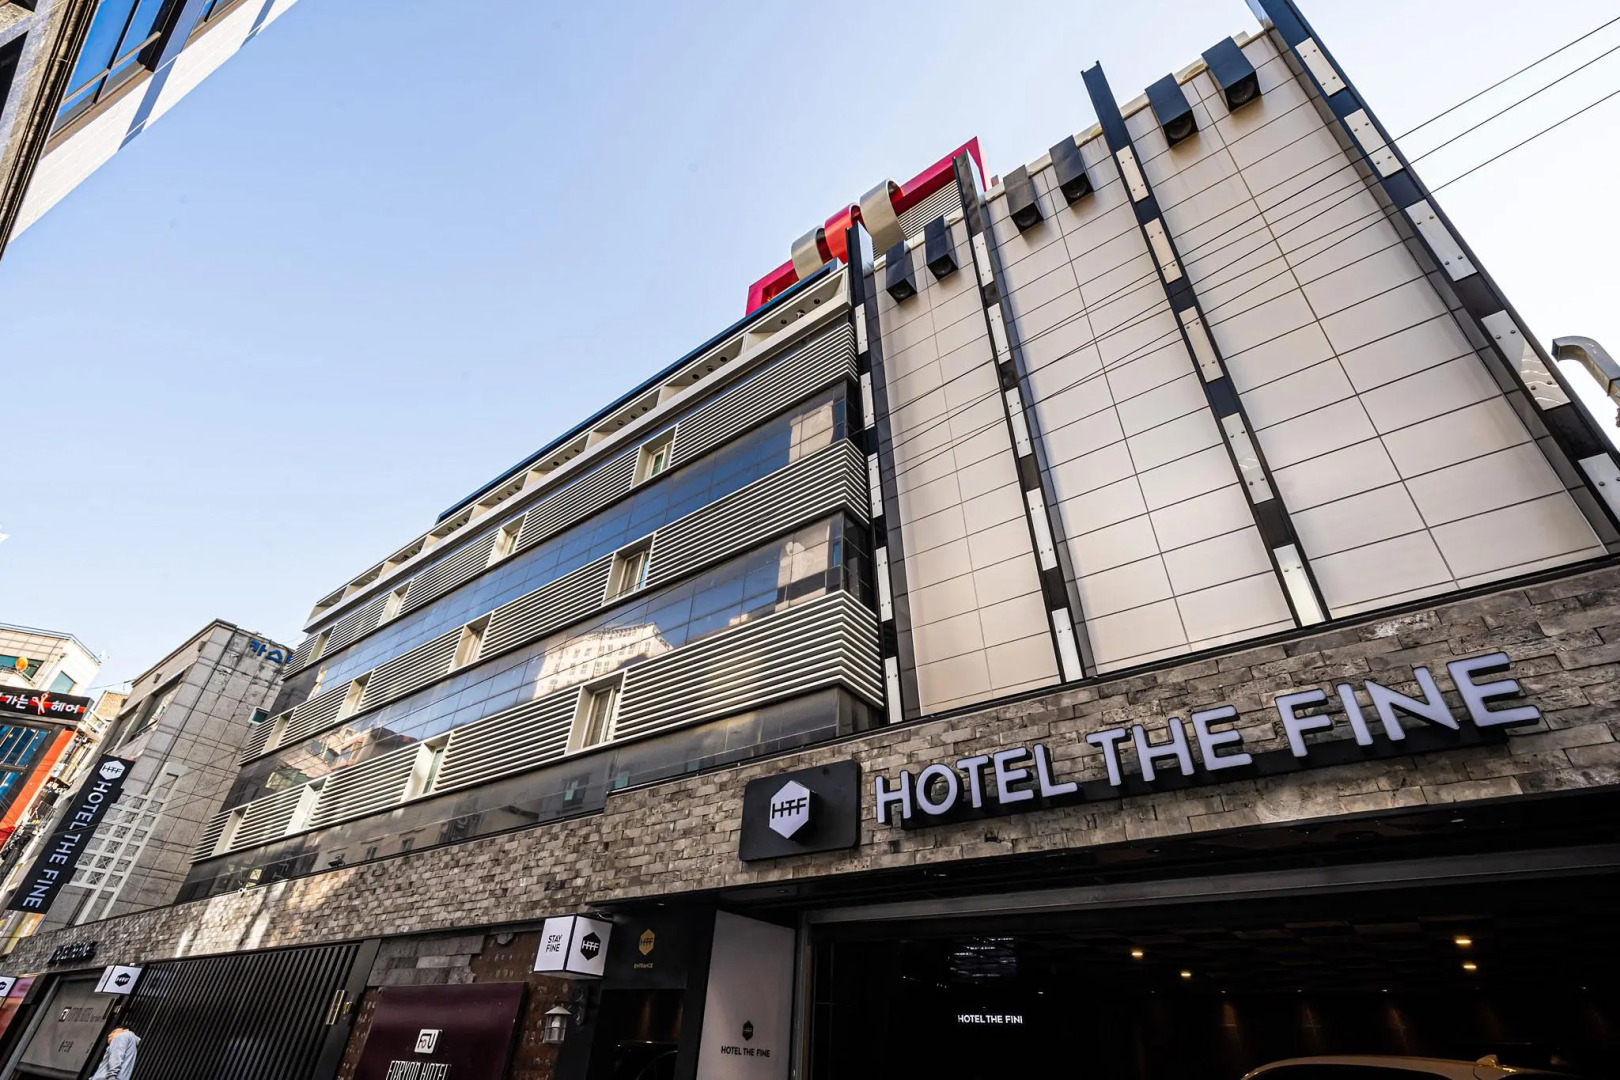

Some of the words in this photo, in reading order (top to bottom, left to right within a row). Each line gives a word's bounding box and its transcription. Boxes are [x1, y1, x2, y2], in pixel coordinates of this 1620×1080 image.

[0, 692, 29, 709] 가는
[51, 700, 79, 714] 헤어
[875, 743, 1079, 825] HOTEL
[1086, 705, 1252, 786] THE
[1274, 651, 1542, 758] FINE
[69, 781, 112, 829] HOTEL
[49, 834, 82, 865] THE
[23, 869, 59, 908] FINE
[546, 944, 560, 952] FINE
[548, 935, 562, 943] STAY
[957, 1014, 985, 1023] HOTEL
[985, 1015, 1003, 1024] THE
[721, 1046, 742, 1055] HOTEL
[743, 1048, 755, 1056] THE
[756, 1049, 770, 1057] FINE
